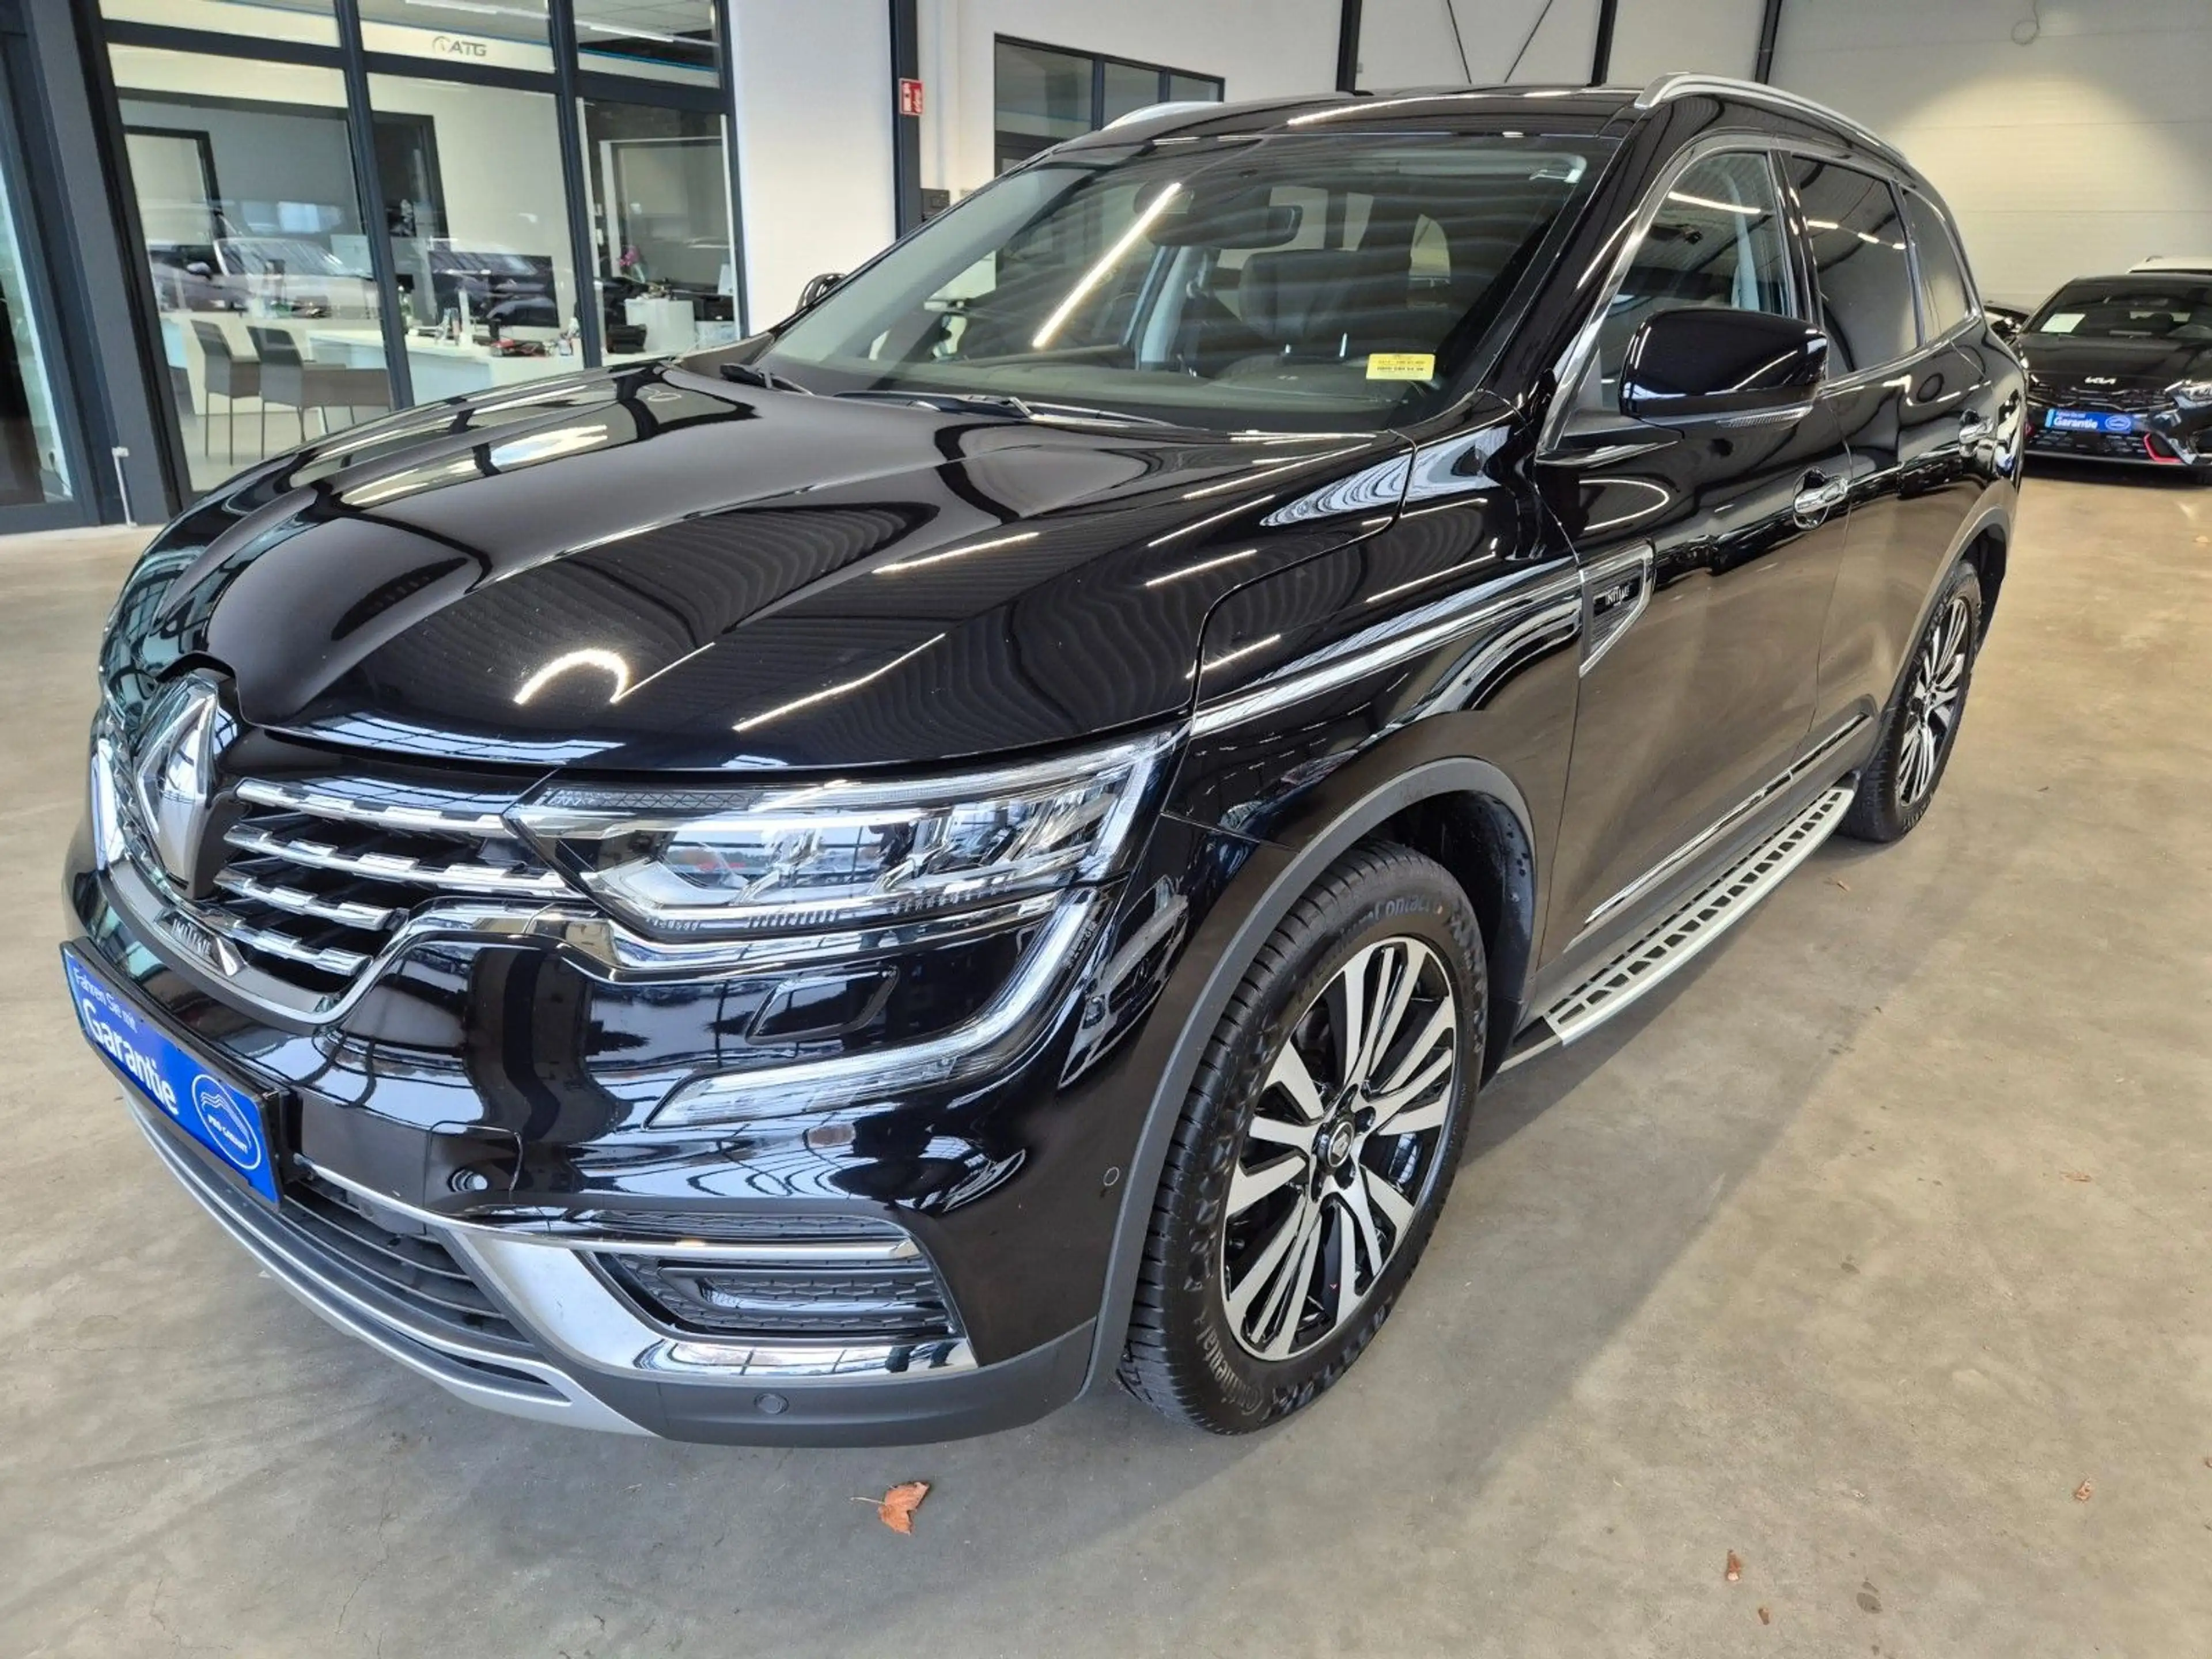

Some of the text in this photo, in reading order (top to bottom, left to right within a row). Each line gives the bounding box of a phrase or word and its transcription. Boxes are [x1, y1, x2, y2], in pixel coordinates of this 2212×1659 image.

[448, 41, 487, 56] ATG
[2054, 417, 2098, 429] Garantie
[82, 998, 179, 1115] Garantie
